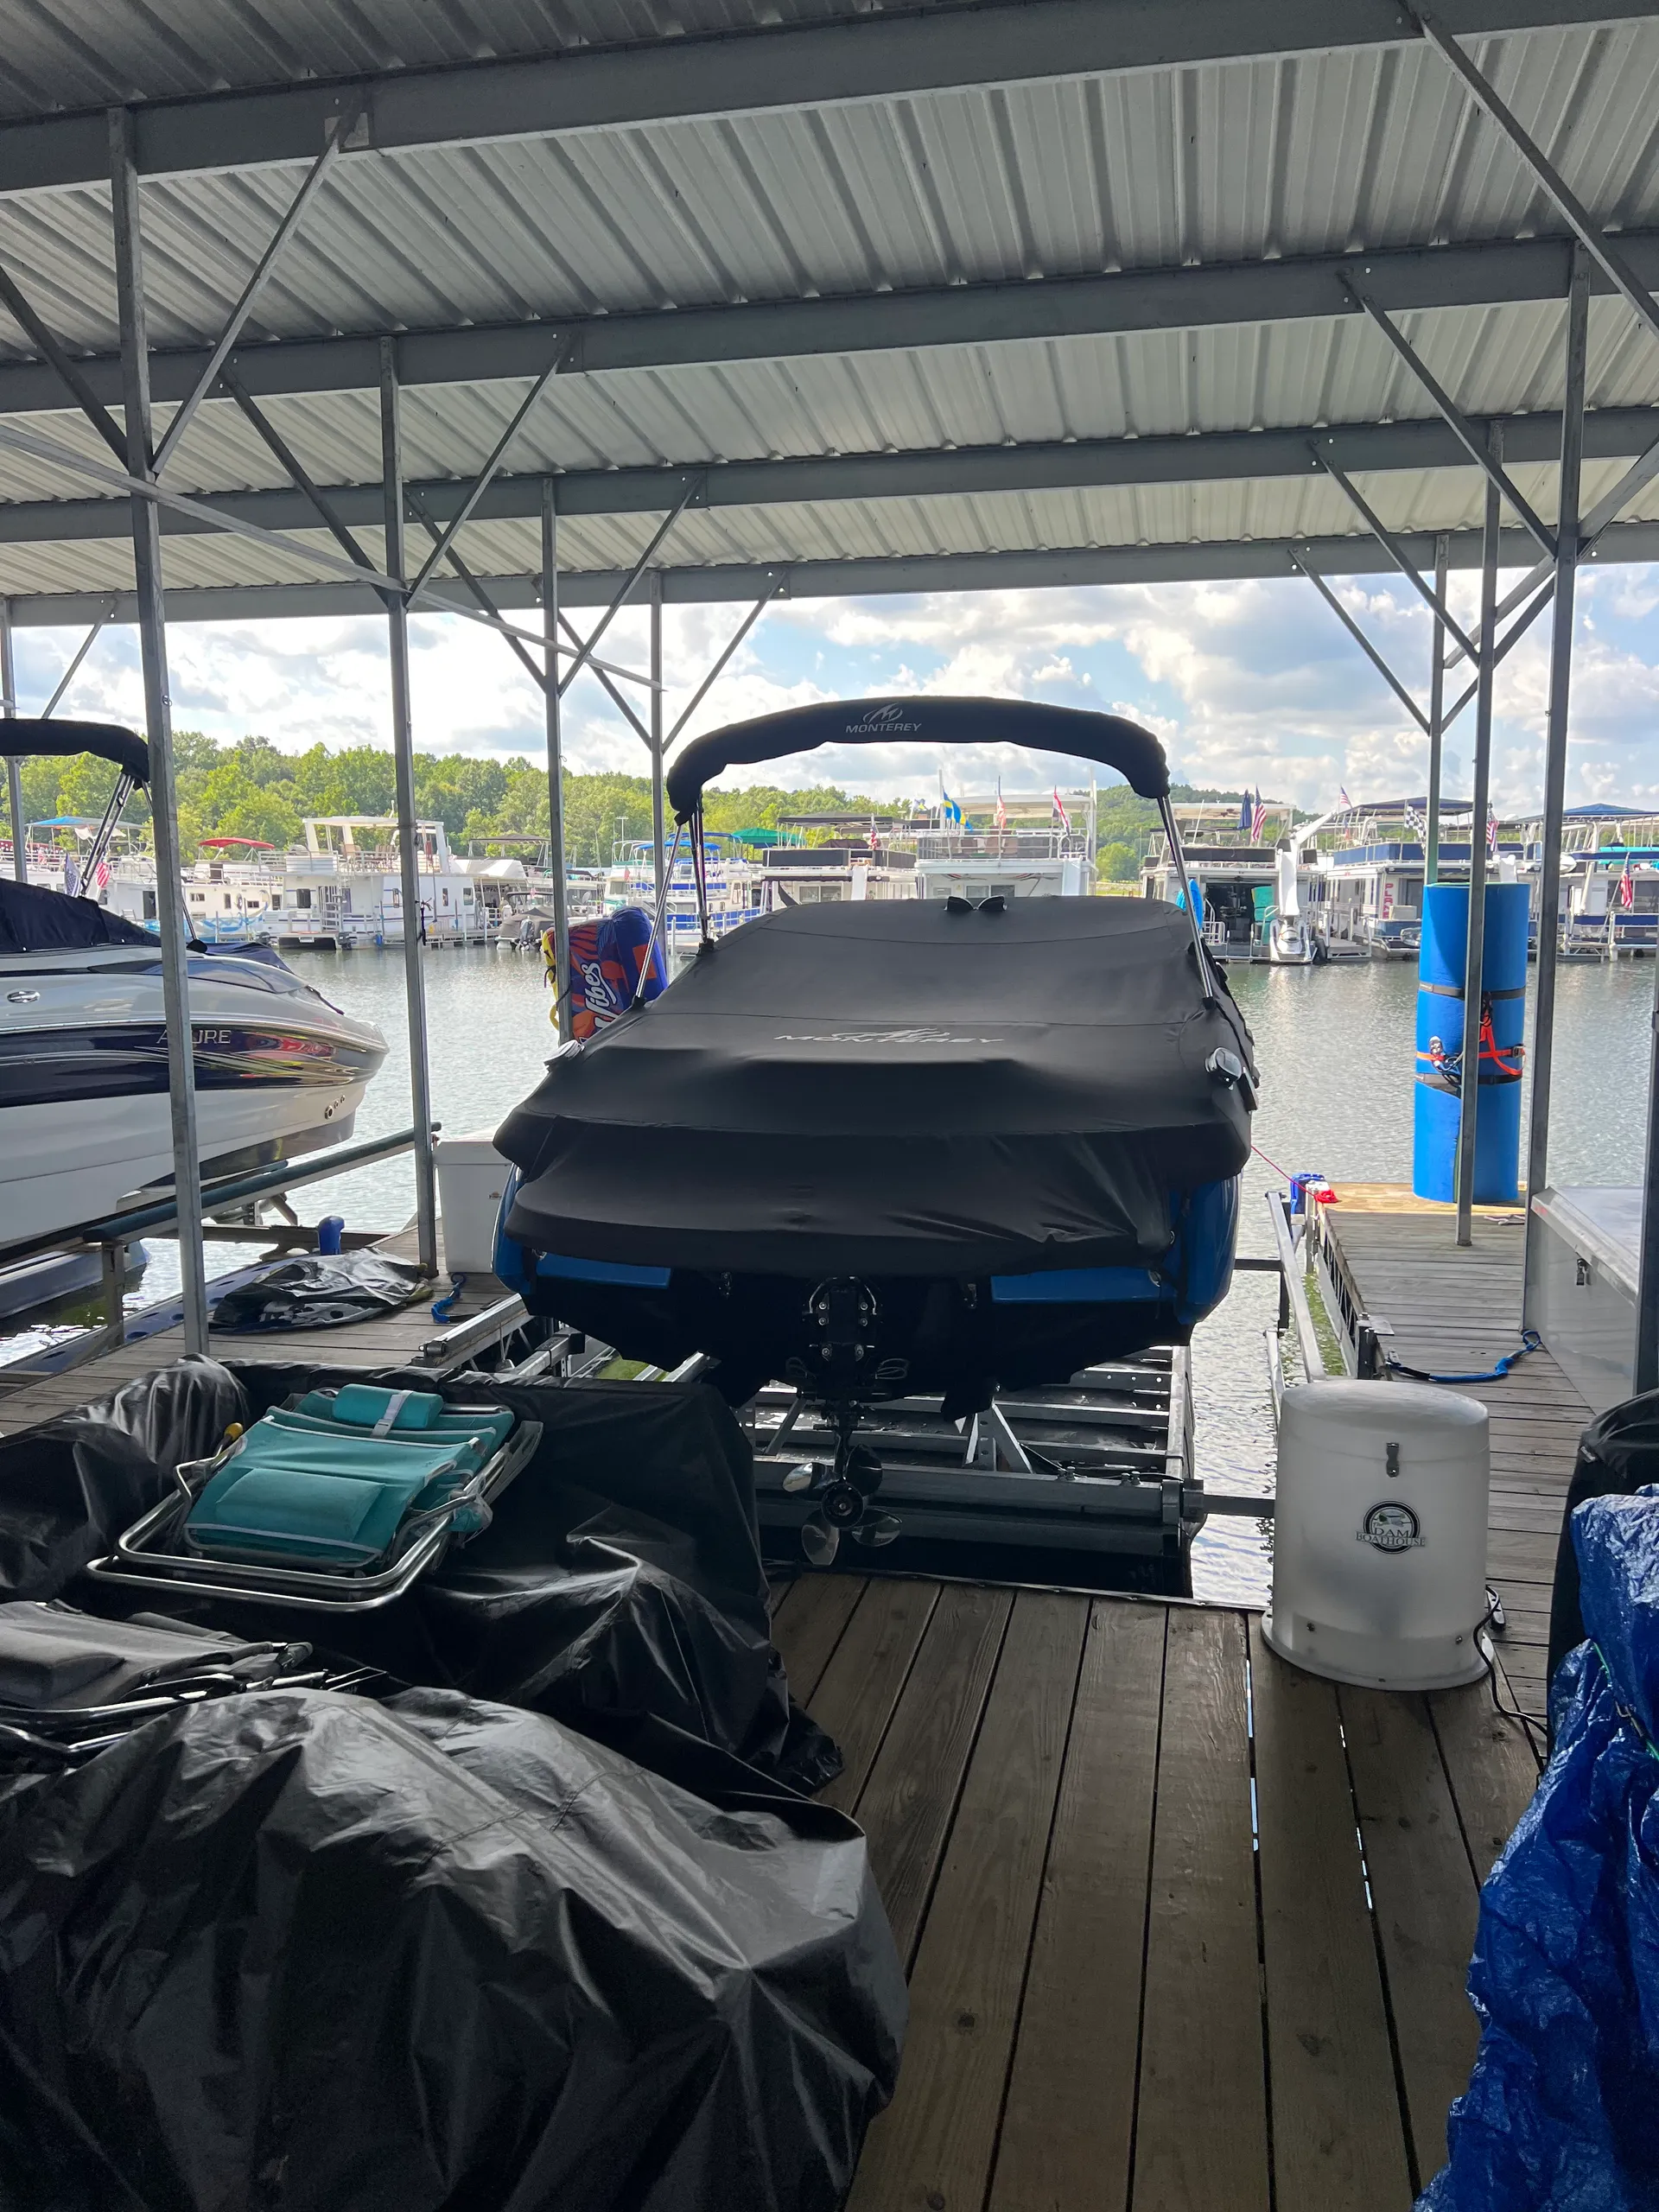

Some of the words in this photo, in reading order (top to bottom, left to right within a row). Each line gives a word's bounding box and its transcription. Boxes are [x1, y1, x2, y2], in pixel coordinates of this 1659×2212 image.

[845, 722, 922, 734] MONTEREY
[156, 1029, 232, 1044] AURE
[773, 1034, 1005, 1043] MONTEREY
[1374, 1527, 1409, 1538] DAM
[1356, 1531, 1426, 1547] BOATHOUSE
